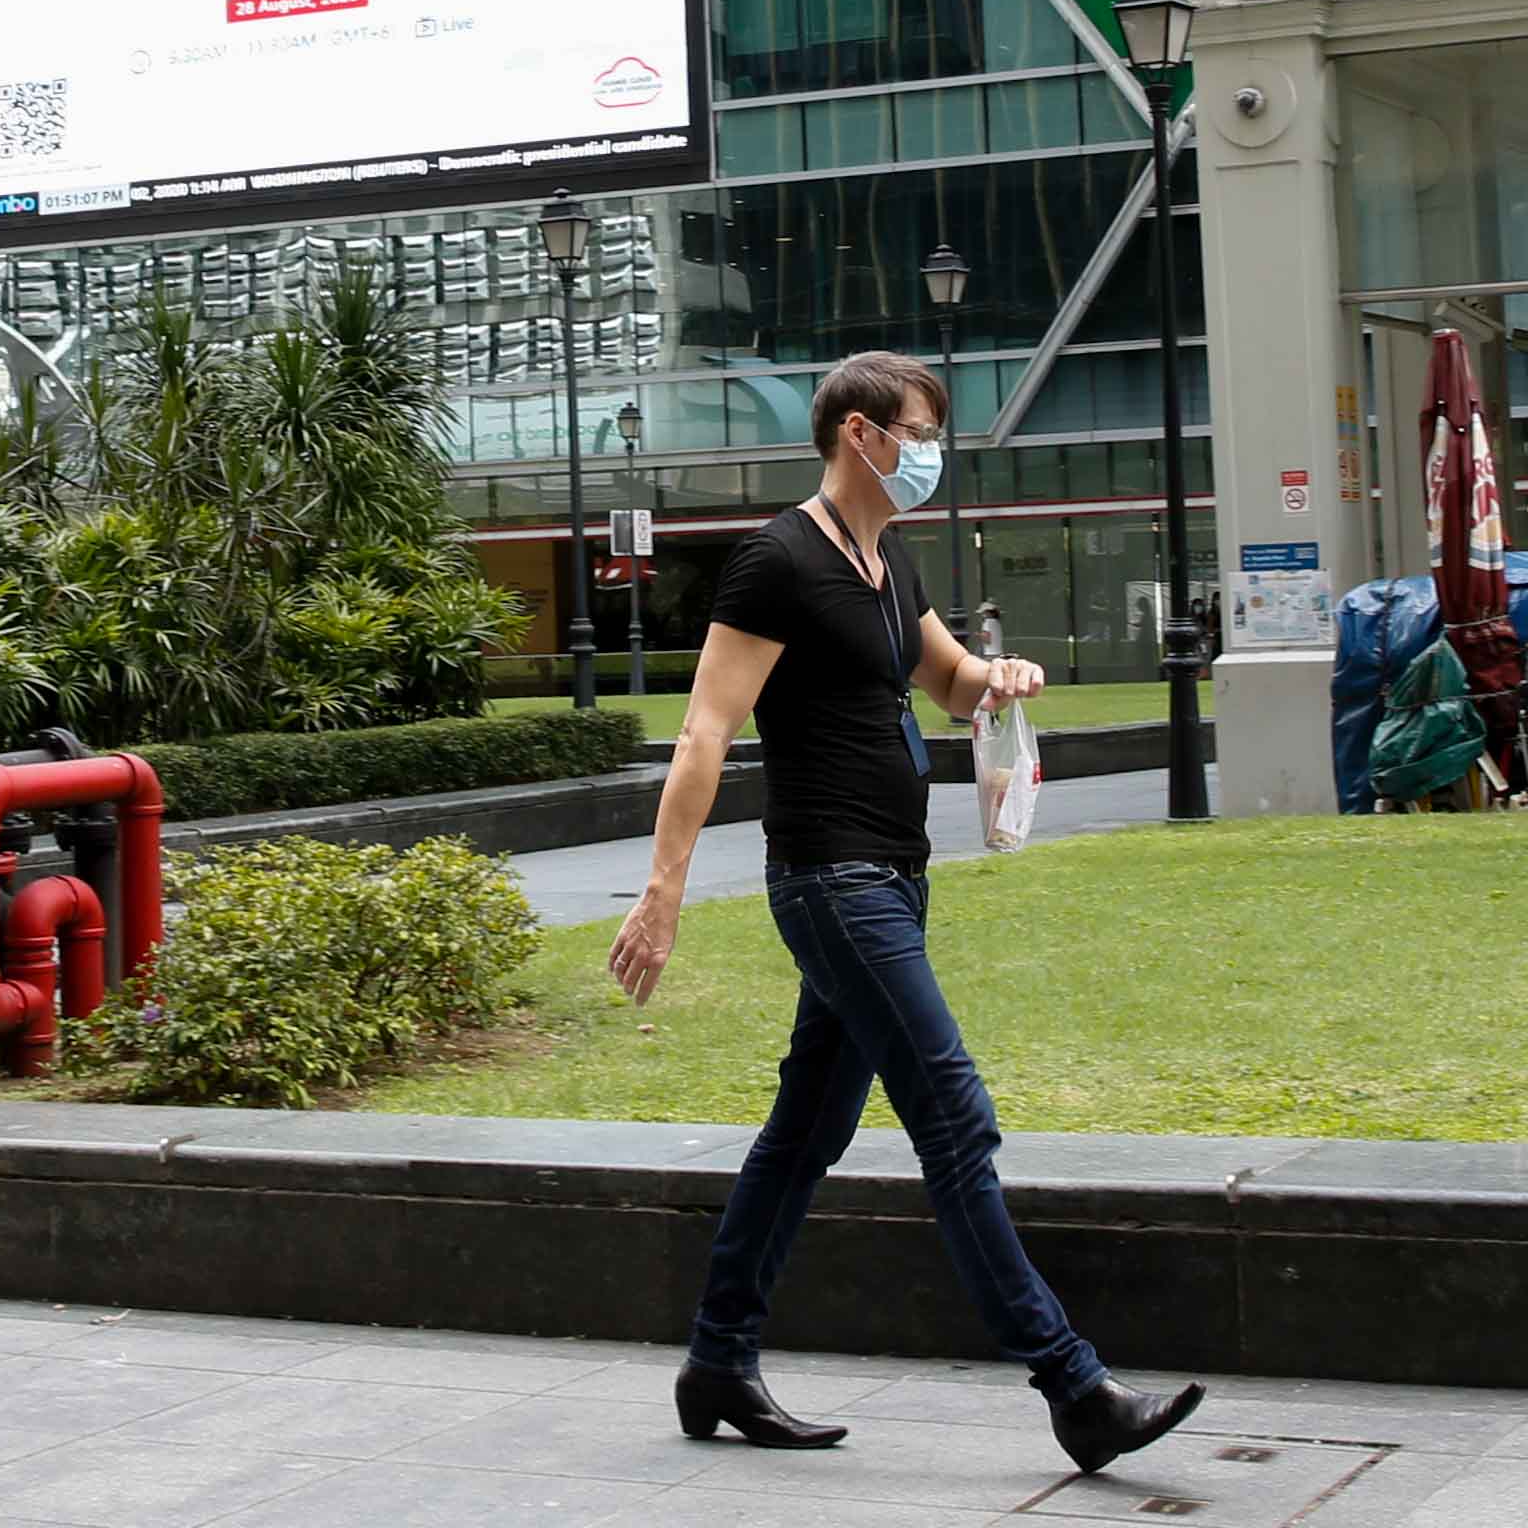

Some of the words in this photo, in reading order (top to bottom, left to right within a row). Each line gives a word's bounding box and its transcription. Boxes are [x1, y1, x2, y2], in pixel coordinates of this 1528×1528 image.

[235, 2, 255, 17] 28
[443, 16, 474, 32] Live
[438, 150, 522, 171] Democratic
[522, 140, 611, 167] presidential
[612, 134, 688, 154] candidate
[45, 193, 98, 209] 01:51:07
[103, 190, 123, 203] PM
